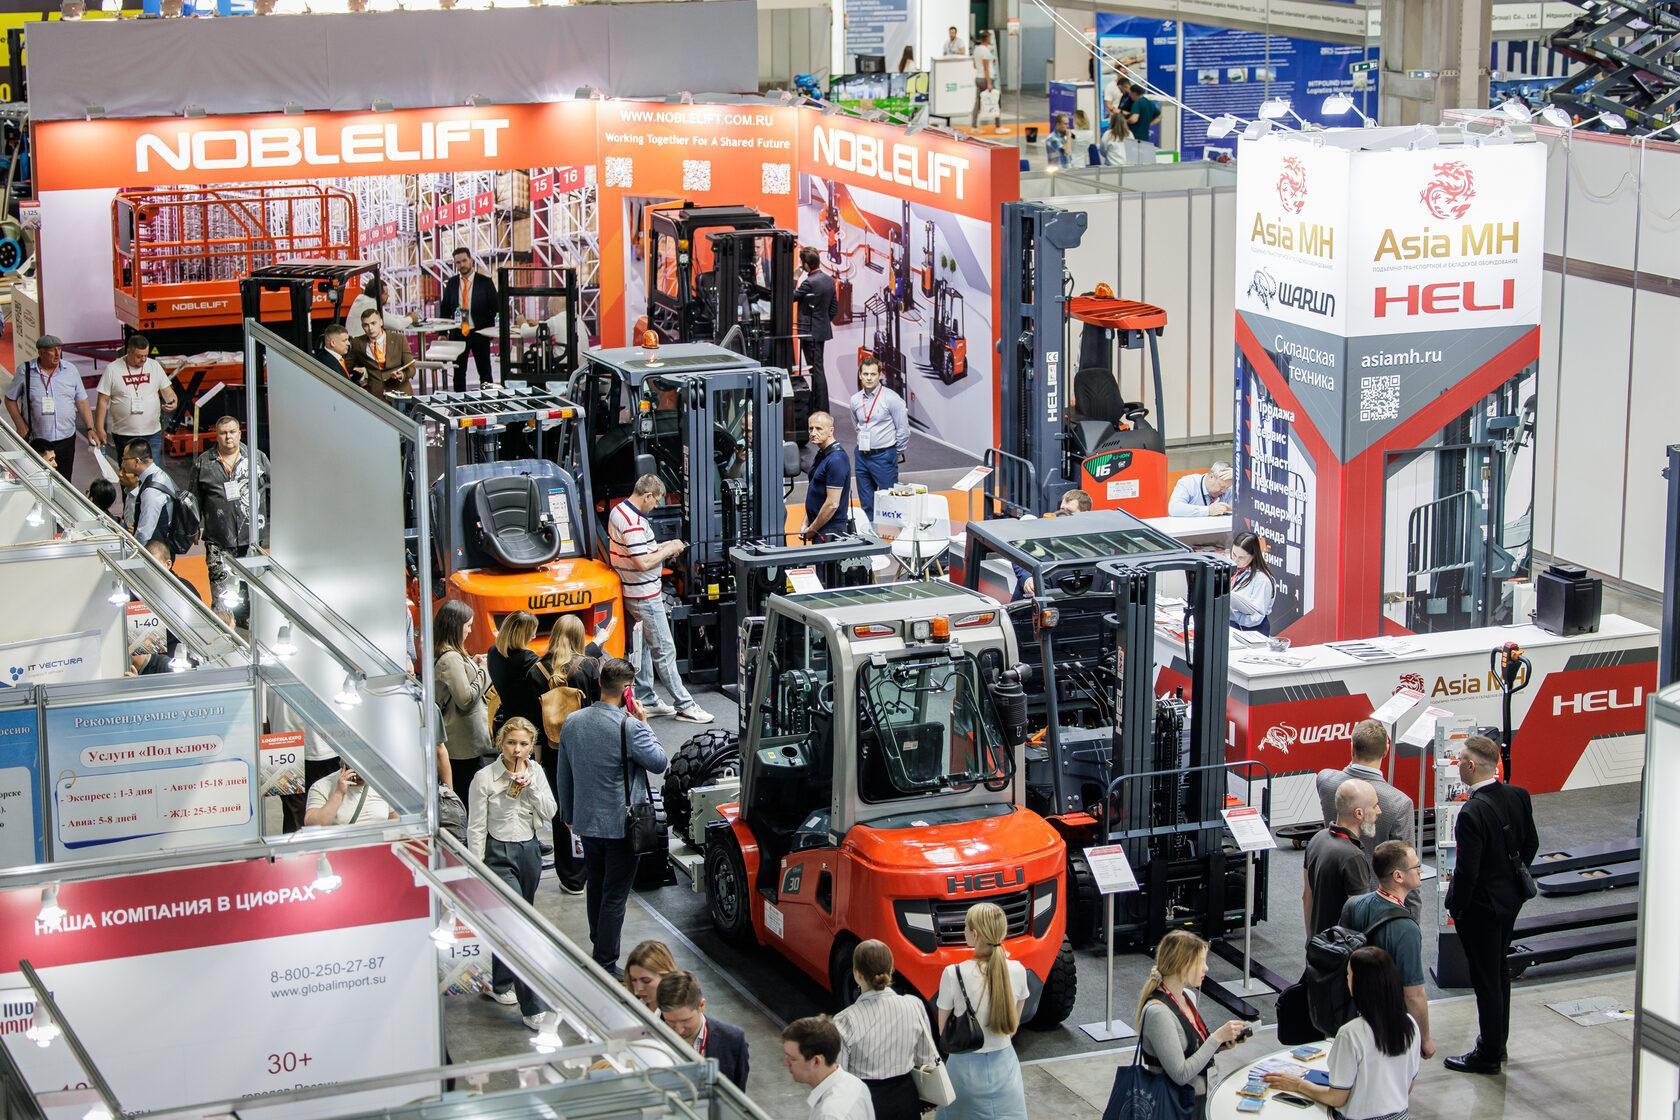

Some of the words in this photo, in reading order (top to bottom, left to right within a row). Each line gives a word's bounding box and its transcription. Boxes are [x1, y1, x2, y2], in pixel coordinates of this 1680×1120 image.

[620, 110, 773, 126] WWW.NOBLELIFT.COM.RU
[136, 118, 509, 172] NOBLELIFT
[605, 132, 643, 145] Working
[647, 134, 688, 146] Together
[692, 135, 708, 146] For
[711, 136, 718, 146] A
[720, 137, 754, 147] Shared
[757, 138, 790, 149] Future
[813, 124, 969, 200] NOBLELIFT
[533, 179, 548, 194] 15
[562, 169, 578, 184] 16
[438, 208, 449, 219] 12
[456, 203, 467, 214] 13
[478, 197, 489, 208] 14
[421, 214, 430, 224] 11
[1251, 212, 1294, 251] Asia
[1299, 221, 1334, 260] MH
[1374, 226, 1451, 262] Asia
[1461, 221, 1520, 257] MH
[171, 300, 229, 311] NOBLELIFT
[1374, 278, 1515, 318] HELI
[1275, 335, 1335, 368] Складская
[1361, 349, 1442, 368] asiamh.ru
[1288, 365, 1335, 391] техника
[1047, 380, 1058, 423] HELI
[1095, 464, 1111, 477] 16
[1254, 499, 1303, 526] поддержка
[1254, 520, 1285, 544] Аренда
[134, 617, 159, 629] 1-40
[28, 664, 36, 672] IT
[39, 656, 83, 670] VECTURA
[1431, 673, 1480, 698] Asia
[1115, 671, 1124, 736] HELI
[1553, 686, 1643, 716] HELI
[74, 711, 178, 728] Рекомендуемые
[181, 706, 225, 720] услуги
[1300, 721, 1359, 744] WARU
[88, 750, 135, 763] Услуги
[138, 745, 172, 757] «Под
[175, 741, 217, 754] ключ»
[269, 753, 296, 765] 1-50
[66, 793, 111, 804] Экспресс
[119, 789, 134, 799] 1-3
[135, 787, 153, 798] дня
[170, 782, 197, 793] Авто:
[200, 778, 224, 789] 15-18
[225, 776, 248, 787] дней
[68, 816, 96, 828] Авиа:
[98, 814, 113, 825] 5-8
[115, 812, 138, 824] дней
[169, 808, 191, 819] ЖД:
[193, 805, 217, 816] 25-35
[220, 803, 242, 813] дней
[788, 877, 801, 892] 30
[947, 866, 1025, 896] HELI
[101, 898, 212, 927] КОМПАНИЯ
[217, 895, 230, 912] В
[236, 883, 316, 911] ЦИФРАХ
[450, 944, 480, 958] 1-53
[271, 956, 385, 983] 8-800-250-27-87
[271, 975, 387, 999] www.globalimport.su
[268, 1051, 312, 1075] 30+
